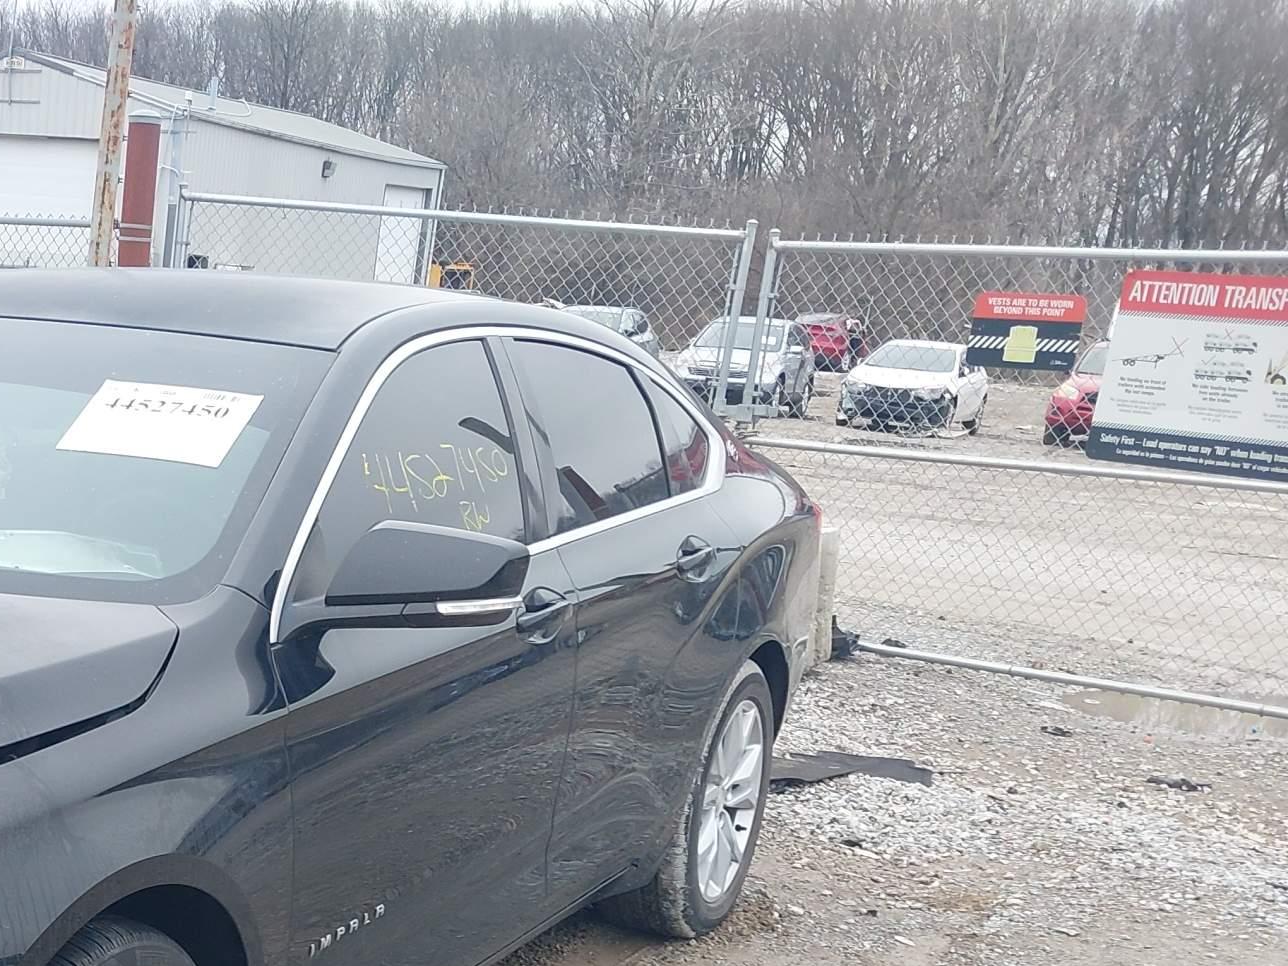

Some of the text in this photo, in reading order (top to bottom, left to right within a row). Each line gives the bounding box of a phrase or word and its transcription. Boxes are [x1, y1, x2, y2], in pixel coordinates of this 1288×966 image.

[988, 297, 1074, 309] VESTS ARE TO BE WORN
[1128, 280, 1220, 307] ATTENTION
[993, 306, 1066, 317] BEYOND THIS POINT
[105, 398, 230, 418] 44527450
[1100, 432, 1121, 445] Safety
[1121, 435, 1135, 446] First
[361, 443, 508, 515] 44527450
[310, 904, 385, 957] IMPALA
